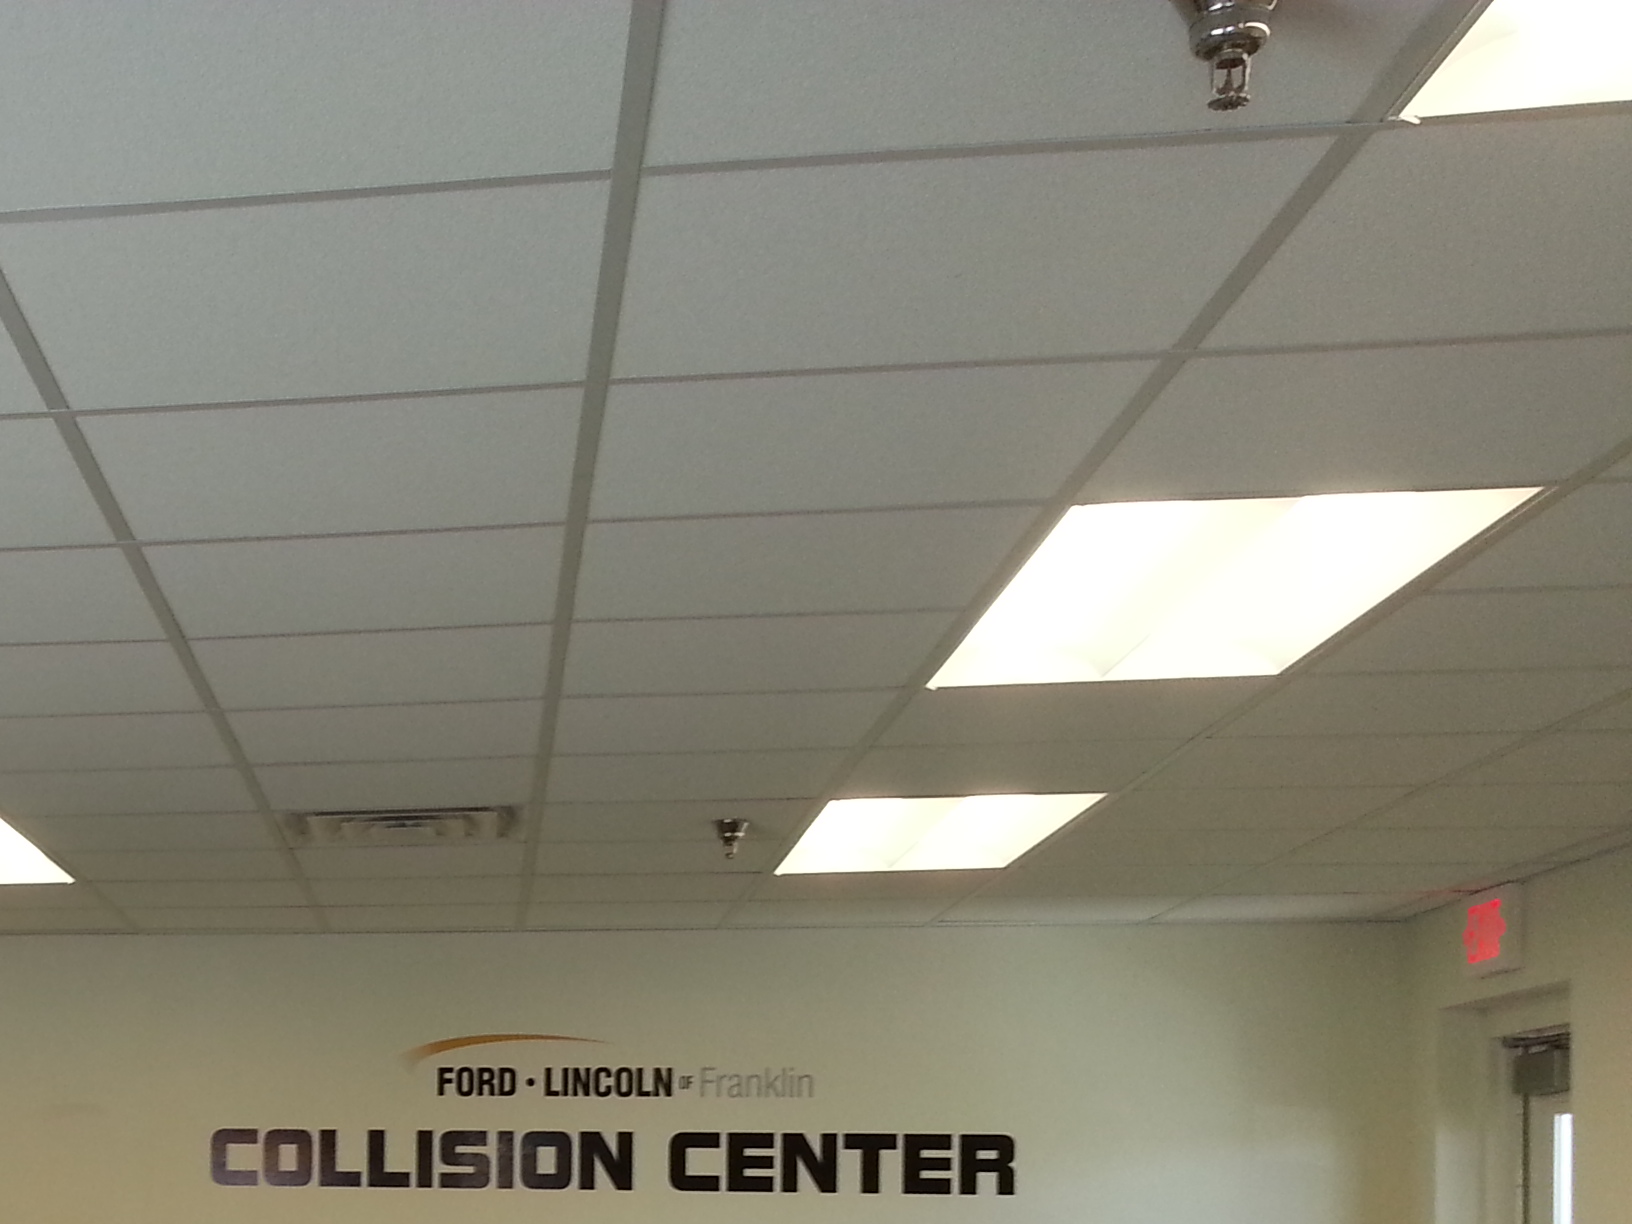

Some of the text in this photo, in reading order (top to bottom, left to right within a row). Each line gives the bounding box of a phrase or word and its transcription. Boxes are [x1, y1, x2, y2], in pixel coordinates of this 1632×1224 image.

[437, 1067, 517, 1097] FORD
[543, 1067, 674, 1098] LINCOLN
[699, 1067, 814, 1099] Franklin
[210, 1127, 1017, 1196] COLLISION CENTER
